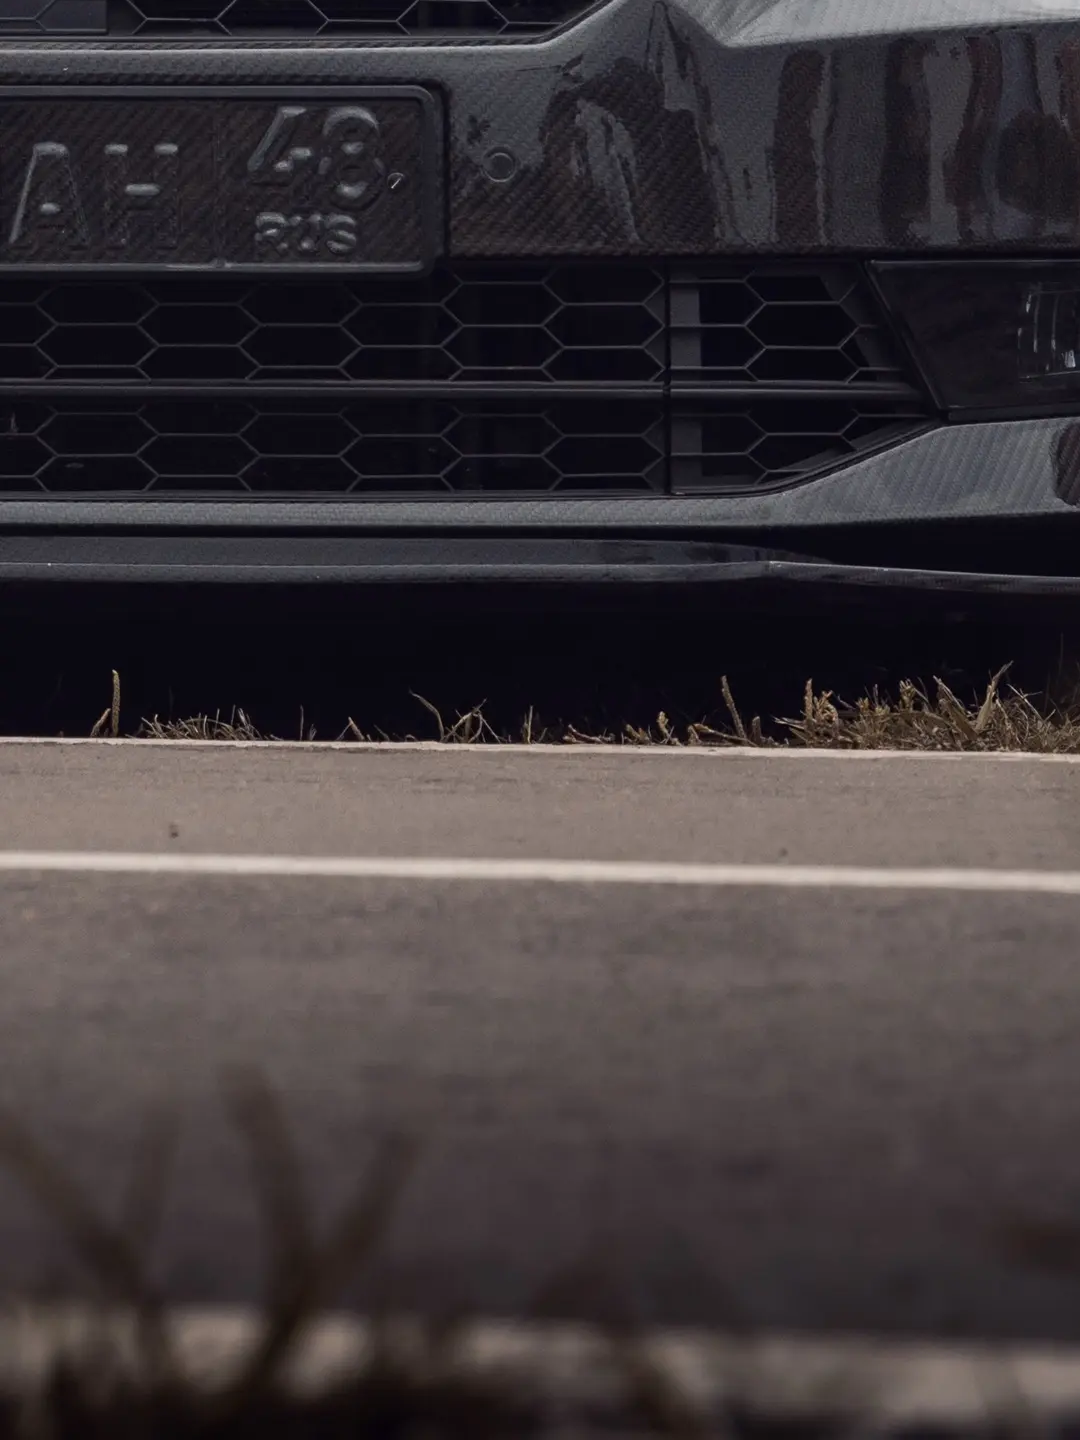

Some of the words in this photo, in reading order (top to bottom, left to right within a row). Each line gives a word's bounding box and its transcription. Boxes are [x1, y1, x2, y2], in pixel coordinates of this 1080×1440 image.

[9, 141, 182, 249] AH
[248, 106, 386, 210] 48
[254, 211, 358, 253] RUS
